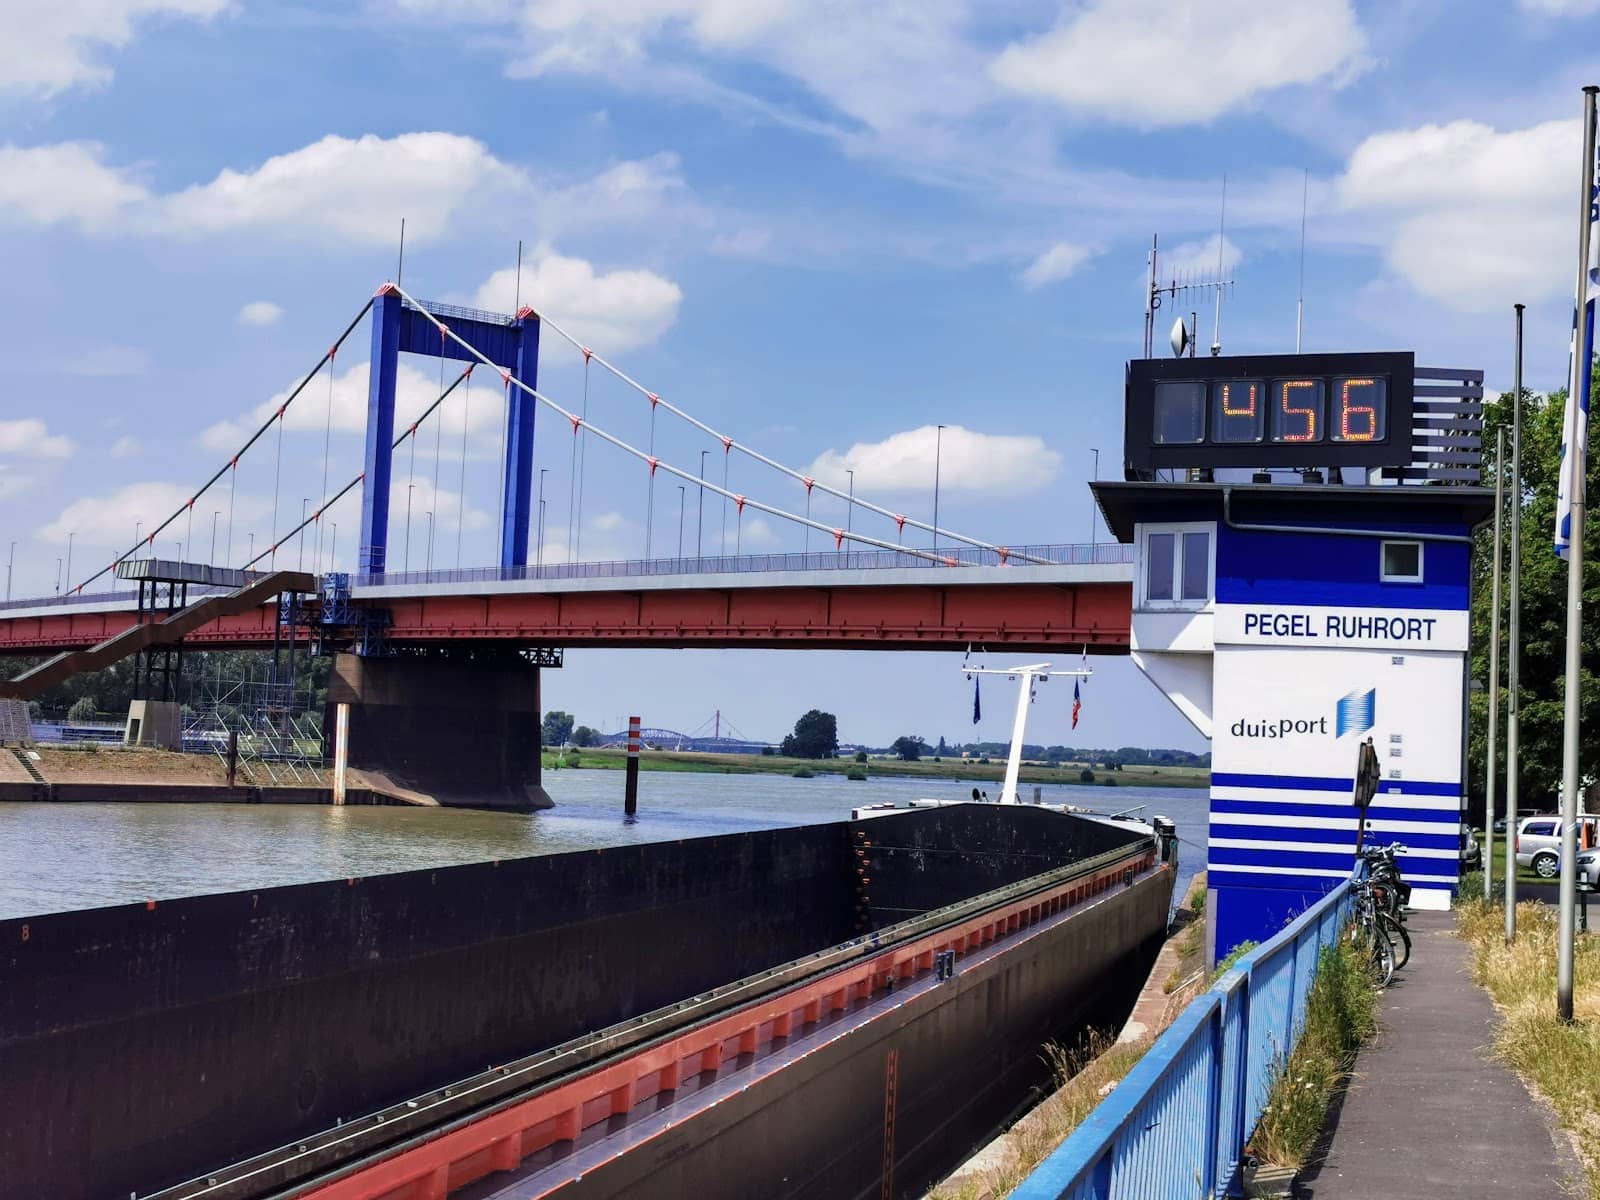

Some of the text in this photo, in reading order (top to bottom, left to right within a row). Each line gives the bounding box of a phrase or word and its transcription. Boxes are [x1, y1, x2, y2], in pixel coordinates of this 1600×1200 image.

[1223, 379, 1376, 442] 456
[1244, 613, 1437, 641] PEGEL RUHRORT
[1231, 716, 1328, 739] duisport
[21, 924, 30, 942] 8
